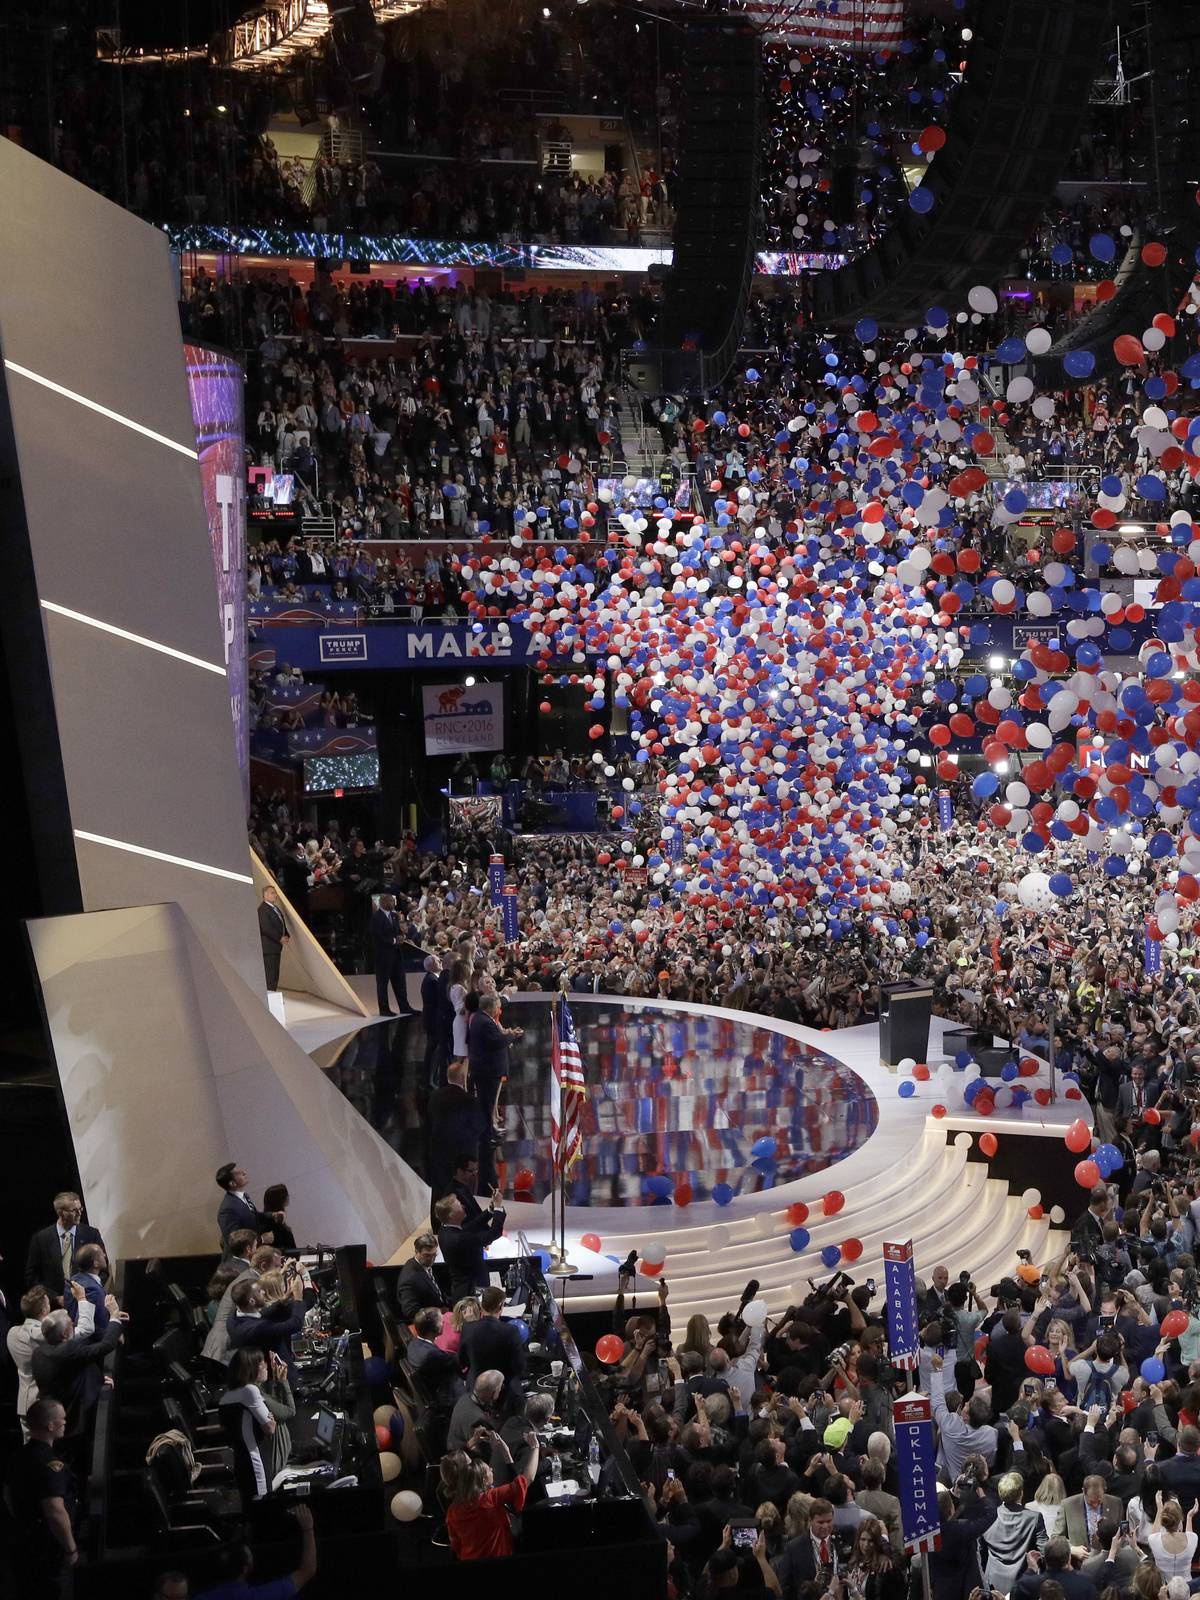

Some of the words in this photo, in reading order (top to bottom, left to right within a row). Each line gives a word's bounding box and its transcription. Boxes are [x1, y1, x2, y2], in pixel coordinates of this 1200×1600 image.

[408, 632, 511, 658] MAKE
[892, 1264, 905, 1344] ALABAMA
[909, 1426, 927, 1524] OKLAHOMA
